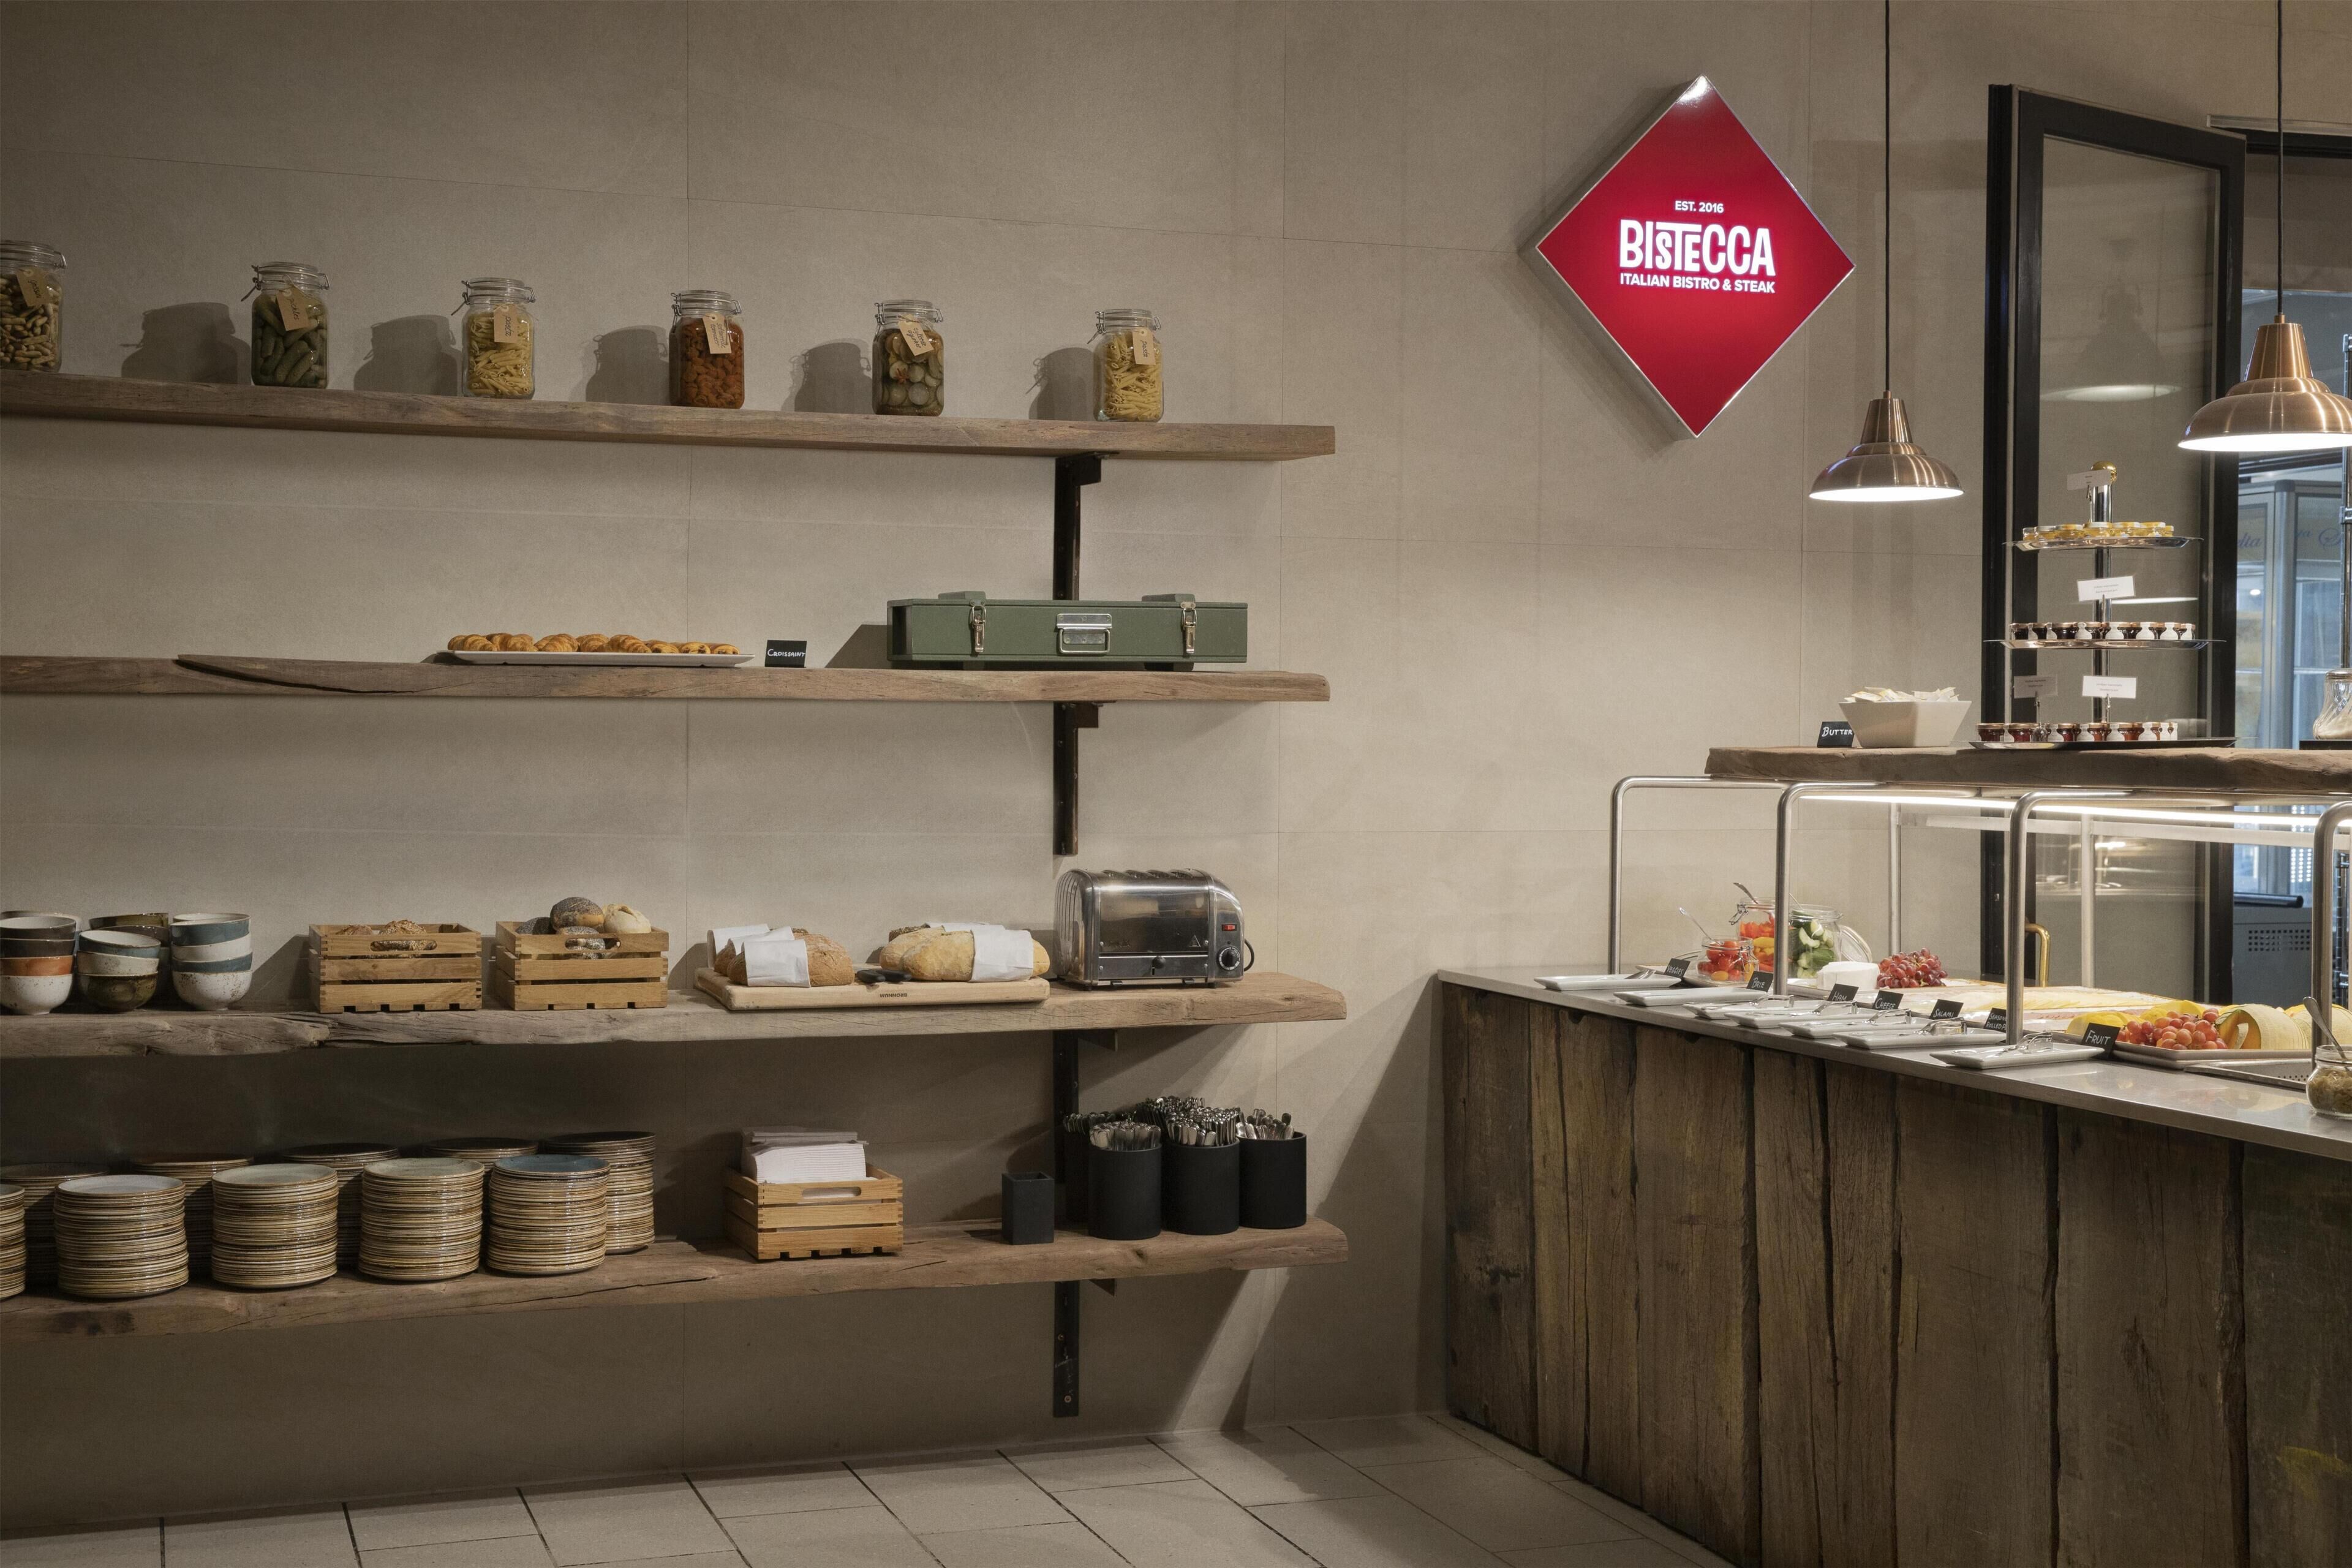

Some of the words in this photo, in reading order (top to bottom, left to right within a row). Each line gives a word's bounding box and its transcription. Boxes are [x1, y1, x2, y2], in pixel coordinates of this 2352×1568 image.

[1675, 200, 1697, 211] EST.
[1698, 202, 1724, 213] 2016
[1619, 219, 1776, 276] BISTECCA
[1620, 273, 1670, 287] ITALIAN
[1673, 276, 1720, 290] BISTRO
[1722, 278, 1732, 291] &
[1734, 279, 1776, 293] STEAK
[287, 298, 300, 320] pickles
[502, 314, 514, 337] pasta
[1140, 339, 1150, 358] pasta
[1822, 726, 1853, 737] BUTTER
[1667, 965, 1684, 976] VEGGIES
[1751, 977, 1765, 989] BRIE
[1832, 990, 1847, 1001] HAM
[1875, 998, 1896, 1009] CHEESE
[1933, 1008, 1954, 1018] SALAMI
[2085, 1030, 2111, 1045] FRUIT
